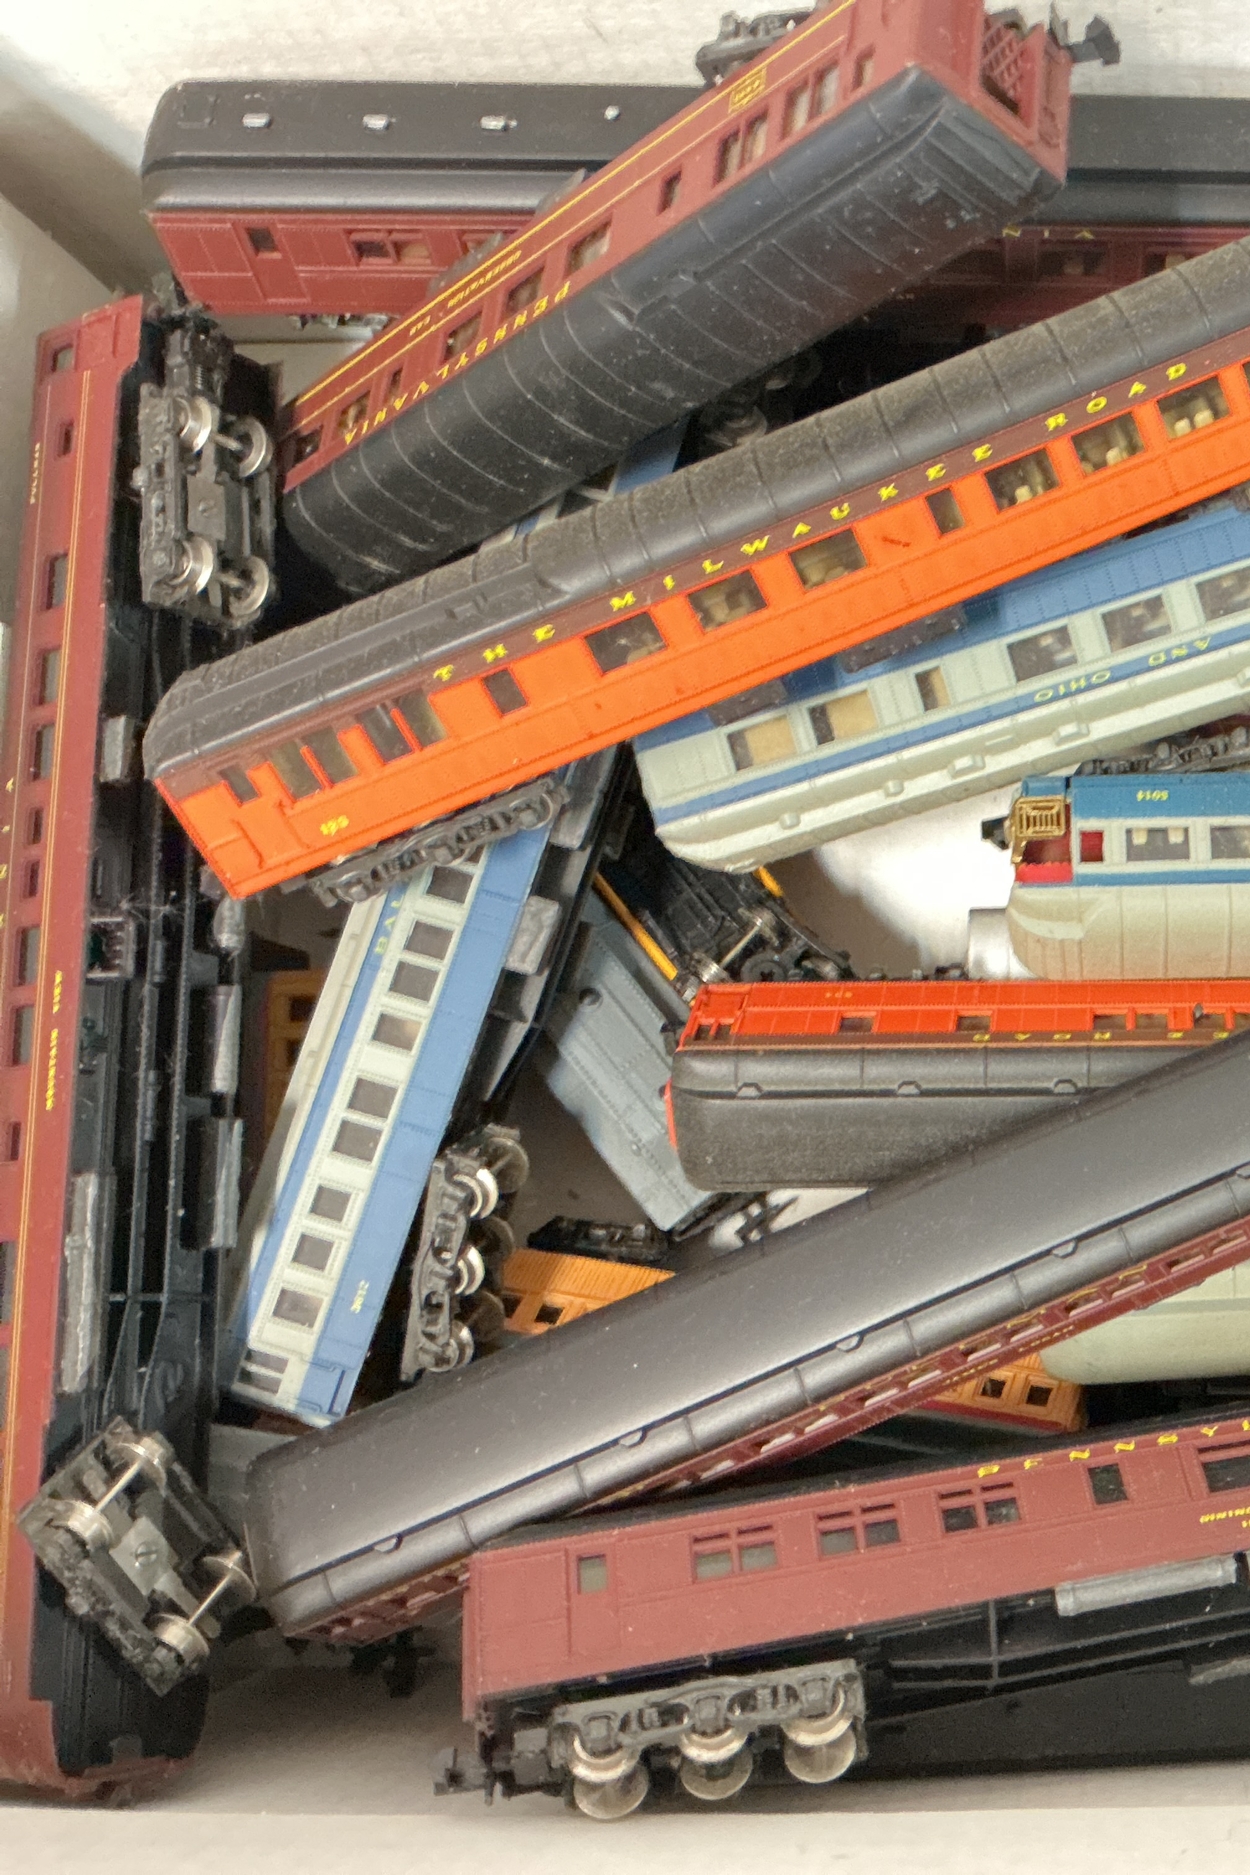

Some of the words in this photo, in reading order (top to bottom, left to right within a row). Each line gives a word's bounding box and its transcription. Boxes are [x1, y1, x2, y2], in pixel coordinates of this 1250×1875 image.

[344, 281, 571, 445] PENNSYLVANIA
[29, 442, 41, 505] PULLMAN
[433, 623, 556, 682] THE
[609, 443, 994, 612] MILWAUKEE
[1044, 362, 1196, 434] ROAD
[1148, 636, 1212, 667] AND
[1034, 670, 1111, 702] OHIO
